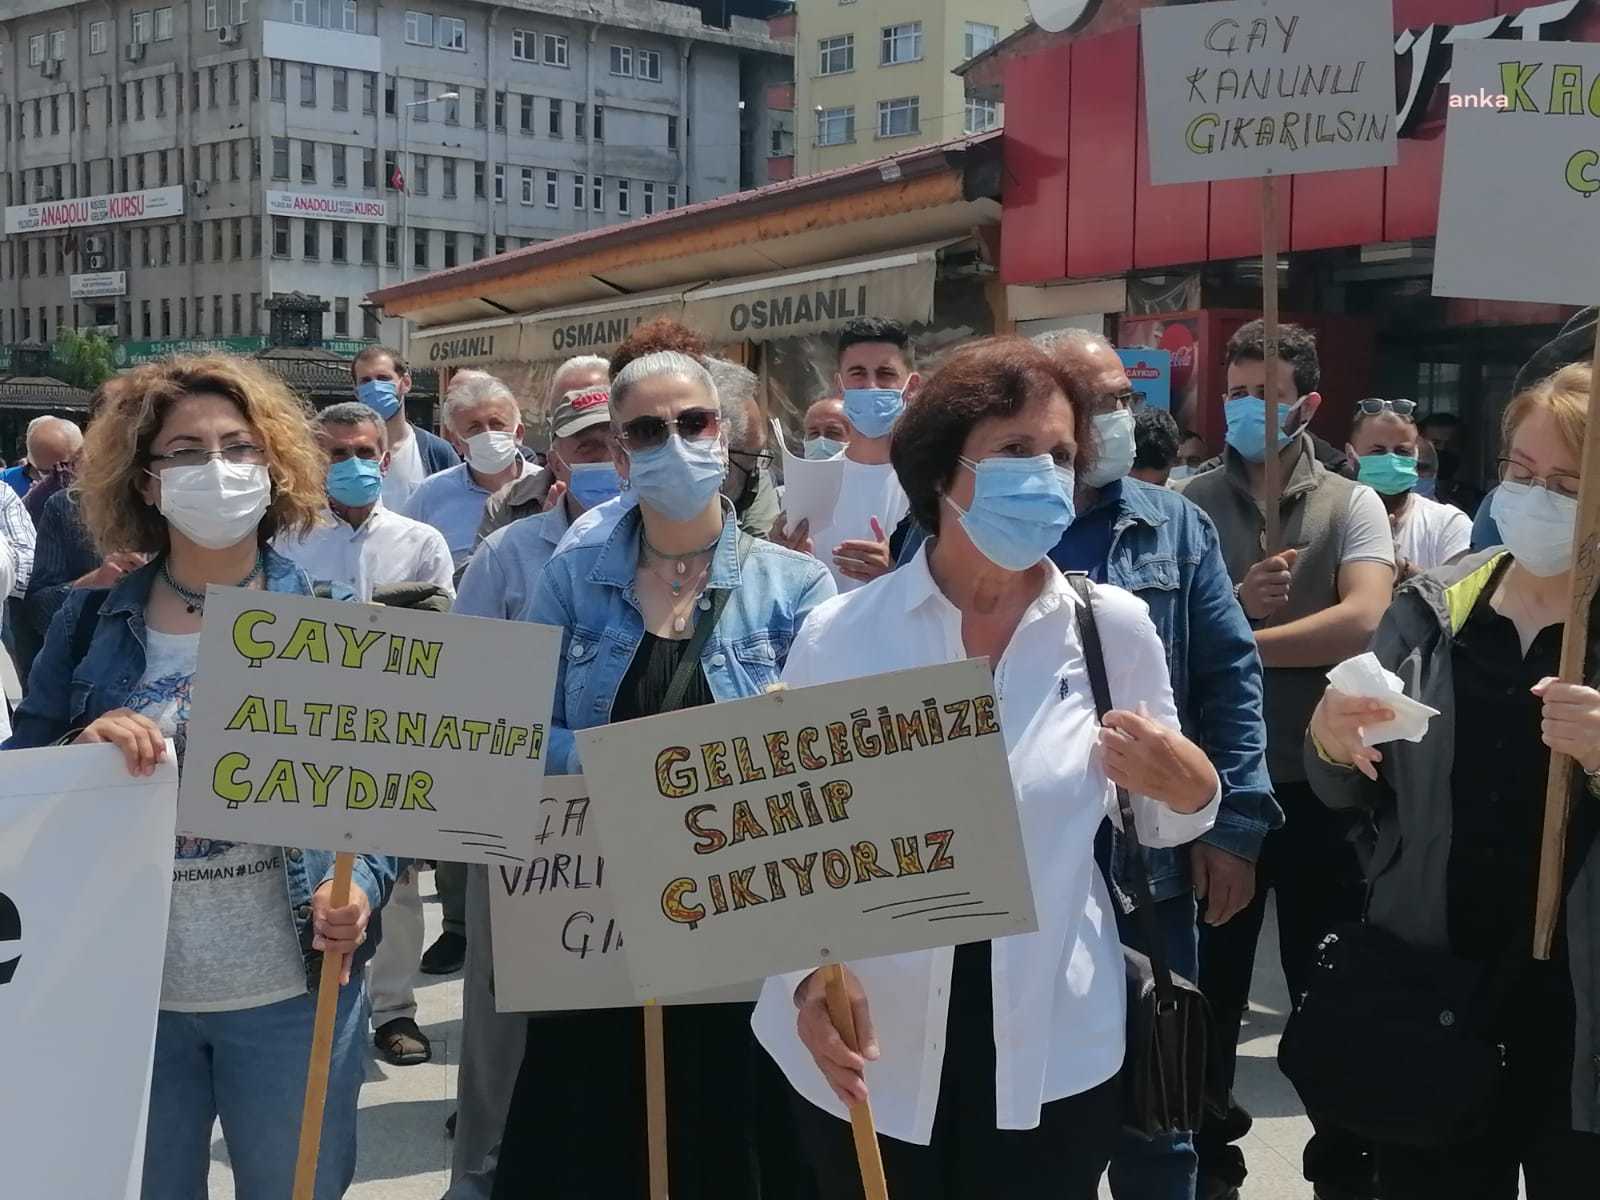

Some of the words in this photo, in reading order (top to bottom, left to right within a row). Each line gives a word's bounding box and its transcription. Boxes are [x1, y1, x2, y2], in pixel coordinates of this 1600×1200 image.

[1185, 61, 1367, 104] KANUNU
[40, 201, 90, 227] ANADOLU
[109, 194, 146, 218] KURSU
[293, 197, 339, 212] ANADOLU
[353, 202, 385, 217] KURSU
[729, 284, 868, 332] OSMANLI
[429, 334, 495, 360] OSMANLI
[232, 609, 444, 679] ÇAYIN
[224, 694, 545, 761] ALTERNATİFİ
[654, 694, 1001, 799] GELECEĞİMİZE
[212, 751, 438, 812] ÇAYDIR
[684, 779, 854, 856] SAHİP
